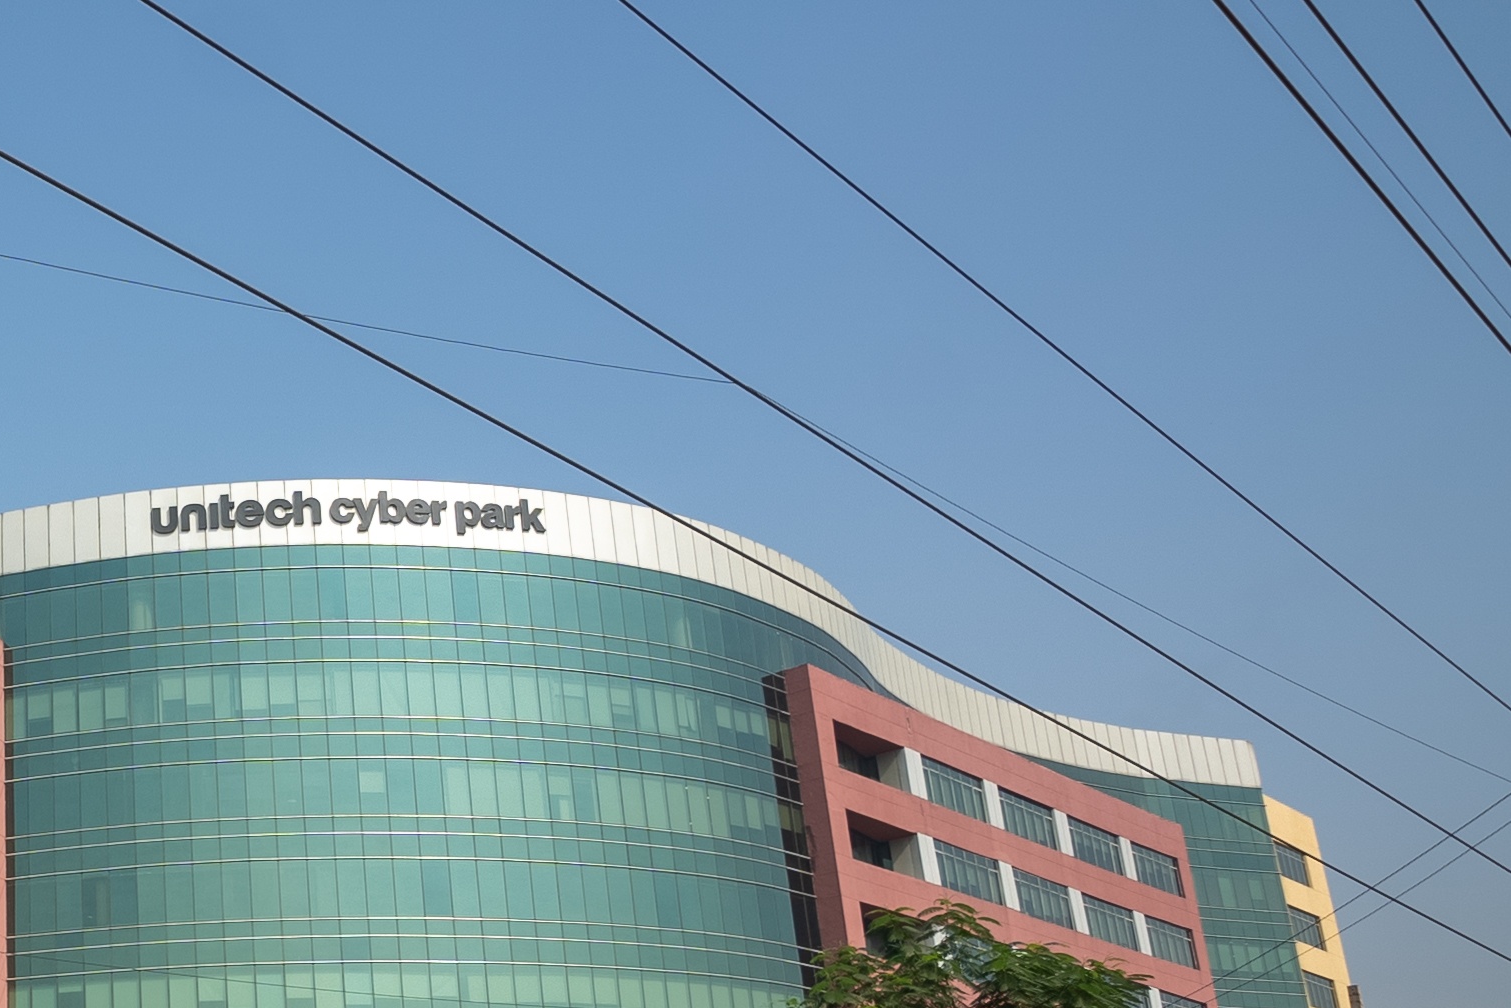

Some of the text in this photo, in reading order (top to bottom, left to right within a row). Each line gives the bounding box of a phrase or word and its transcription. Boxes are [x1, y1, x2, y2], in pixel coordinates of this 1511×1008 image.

[151, 491, 547, 536] unitech cyber park
